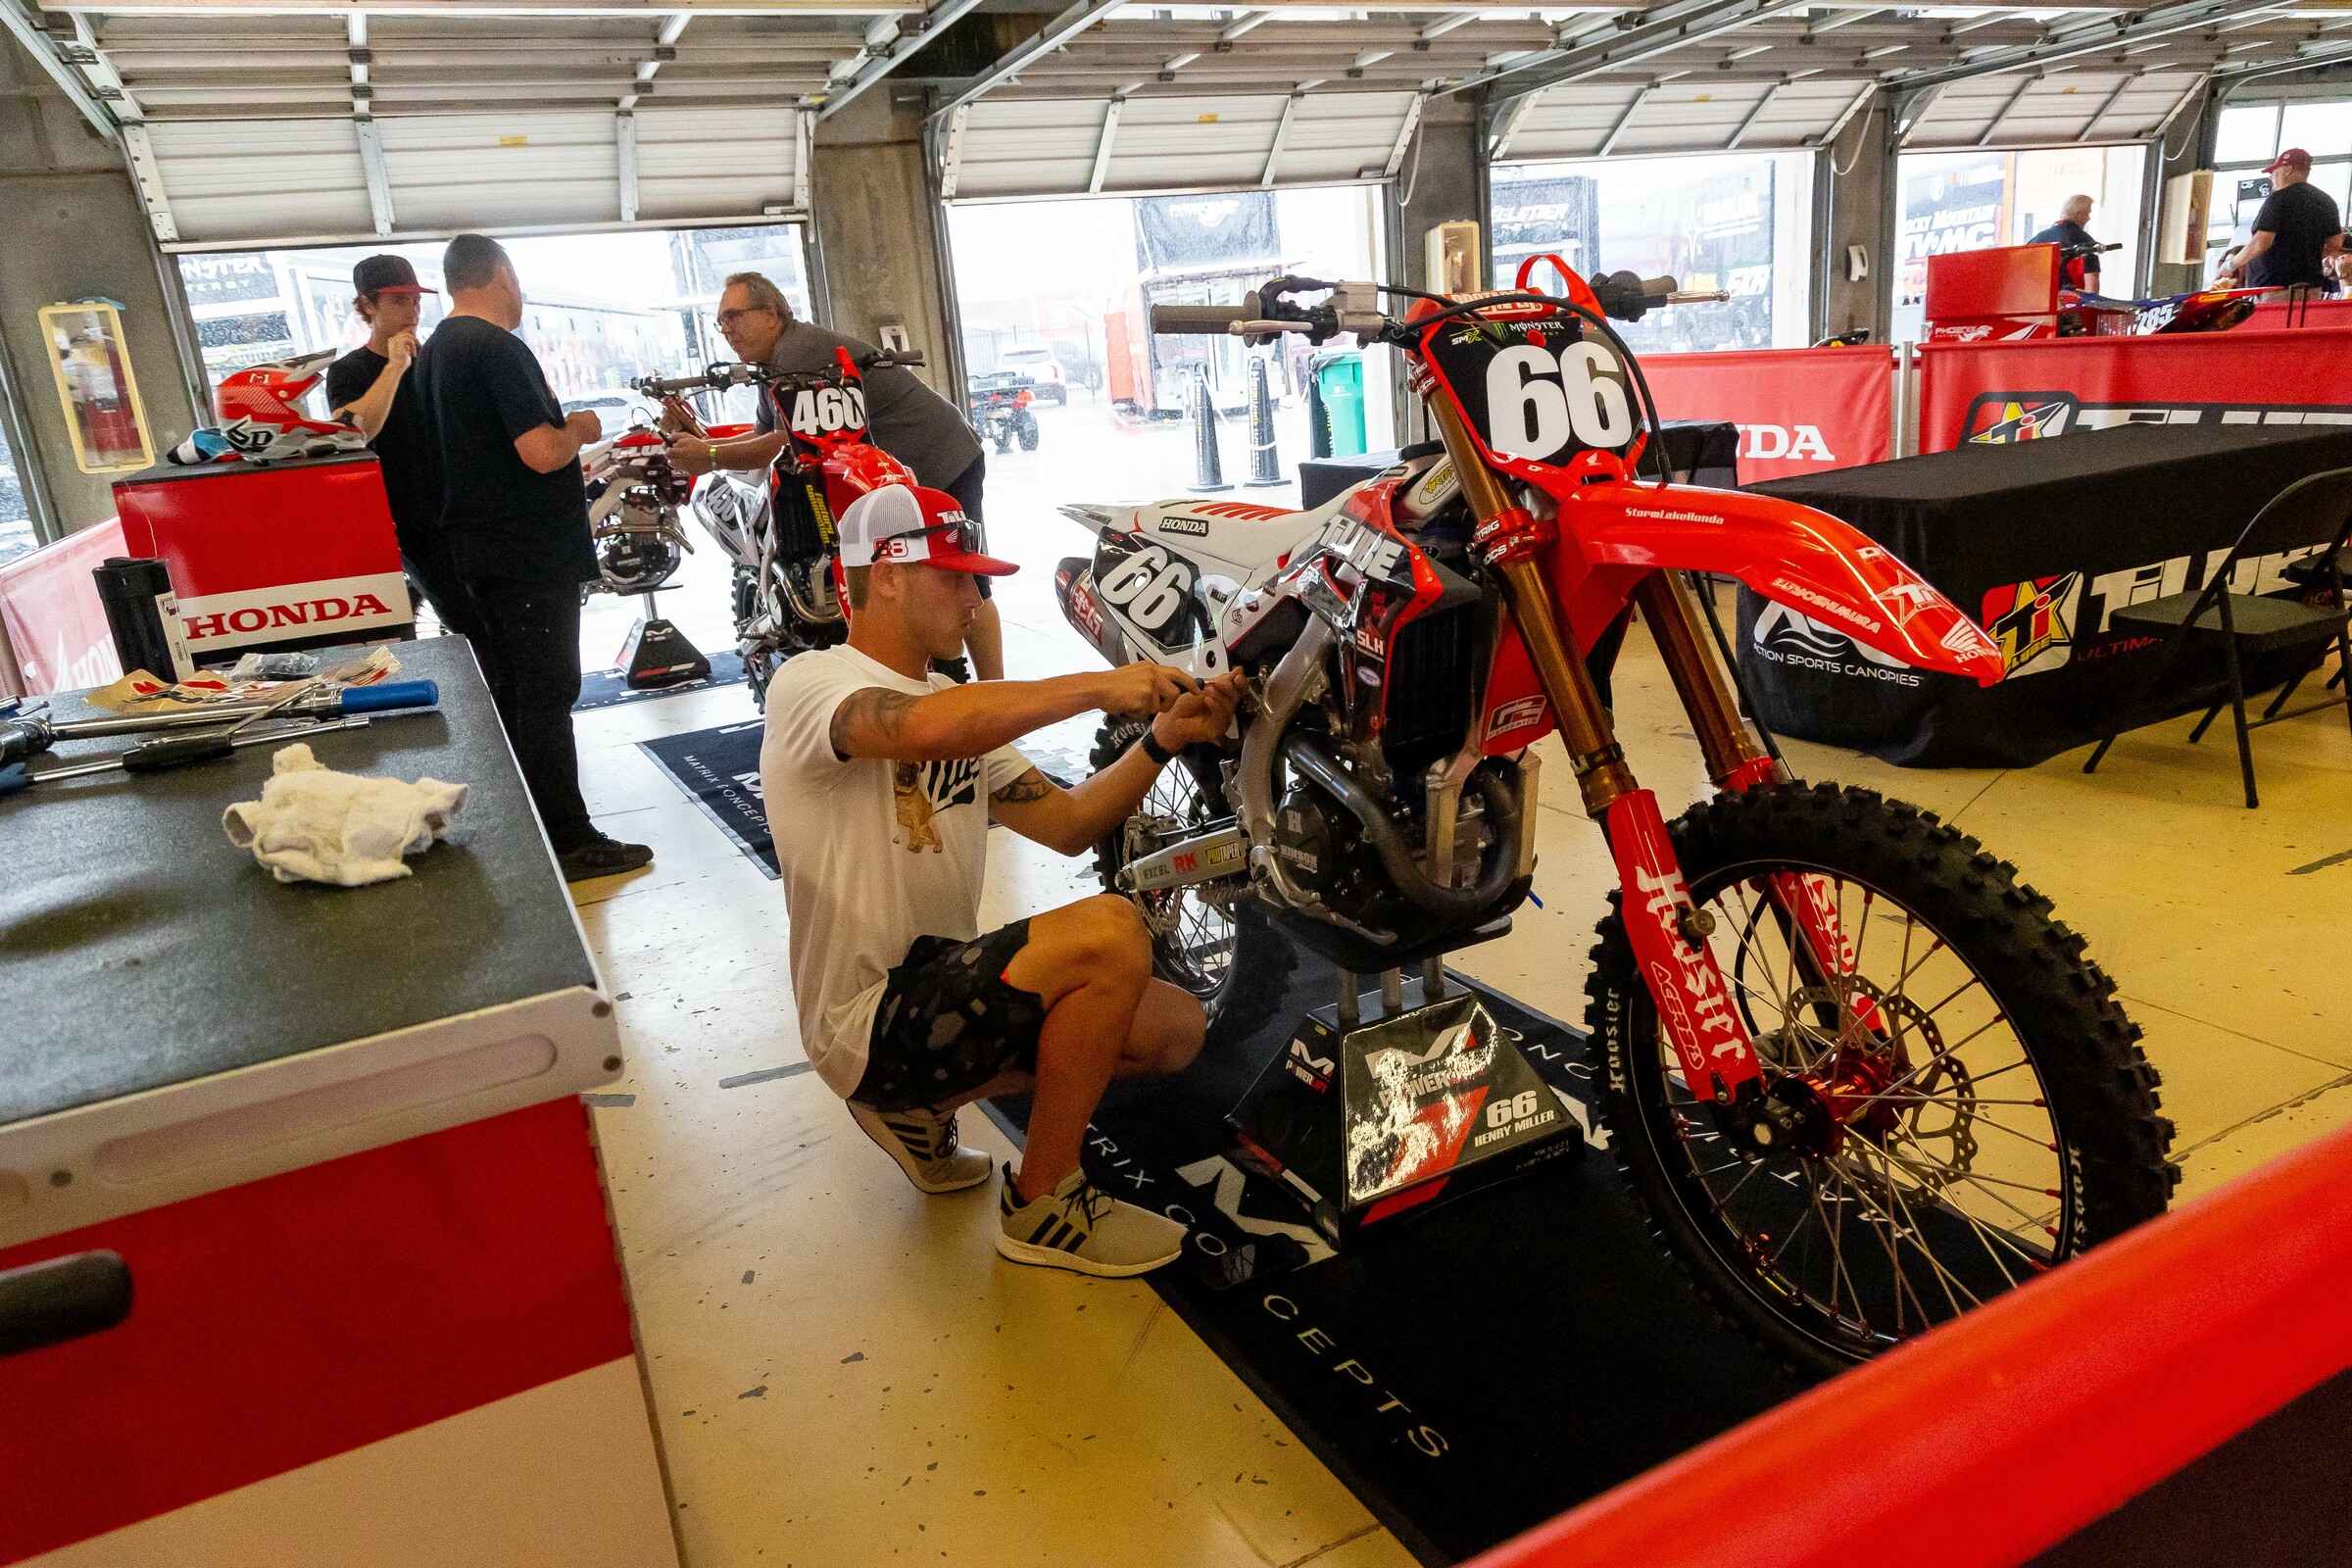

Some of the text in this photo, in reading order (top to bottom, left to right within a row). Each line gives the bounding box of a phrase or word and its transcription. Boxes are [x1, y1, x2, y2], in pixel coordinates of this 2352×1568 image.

[185, 278, 250, 292] NERGY
[1509, 320, 1565, 332] MONSTER
[791, 386, 866, 435] 460
[1487, 341, 1633, 462] 66
[1159, 517, 1207, 534] HONDA
[1625, 507, 1725, 525] StormLakeHonda
[1100, 546, 1192, 630] 66
[184, 593, 393, 640] HONDA
[1789, 585, 1882, 634] YOSHIMURA
[1356, 629, 1385, 655] SLH
[2010, 632, 2053, 668] LUBE
[1787, 654, 1841, 673] SPORTS
[1844, 664, 1920, 687] CANOPIES
[683, 755, 720, 783] MATRIX
[1143, 864, 1171, 880] EXCEL
[1172, 852, 1200, 873] RK
[1606, 987, 1626, 1094] Hoosier
[1487, 1090, 1539, 1128] 66
[1474, 1109, 1555, 1148] HENRY MILLER
